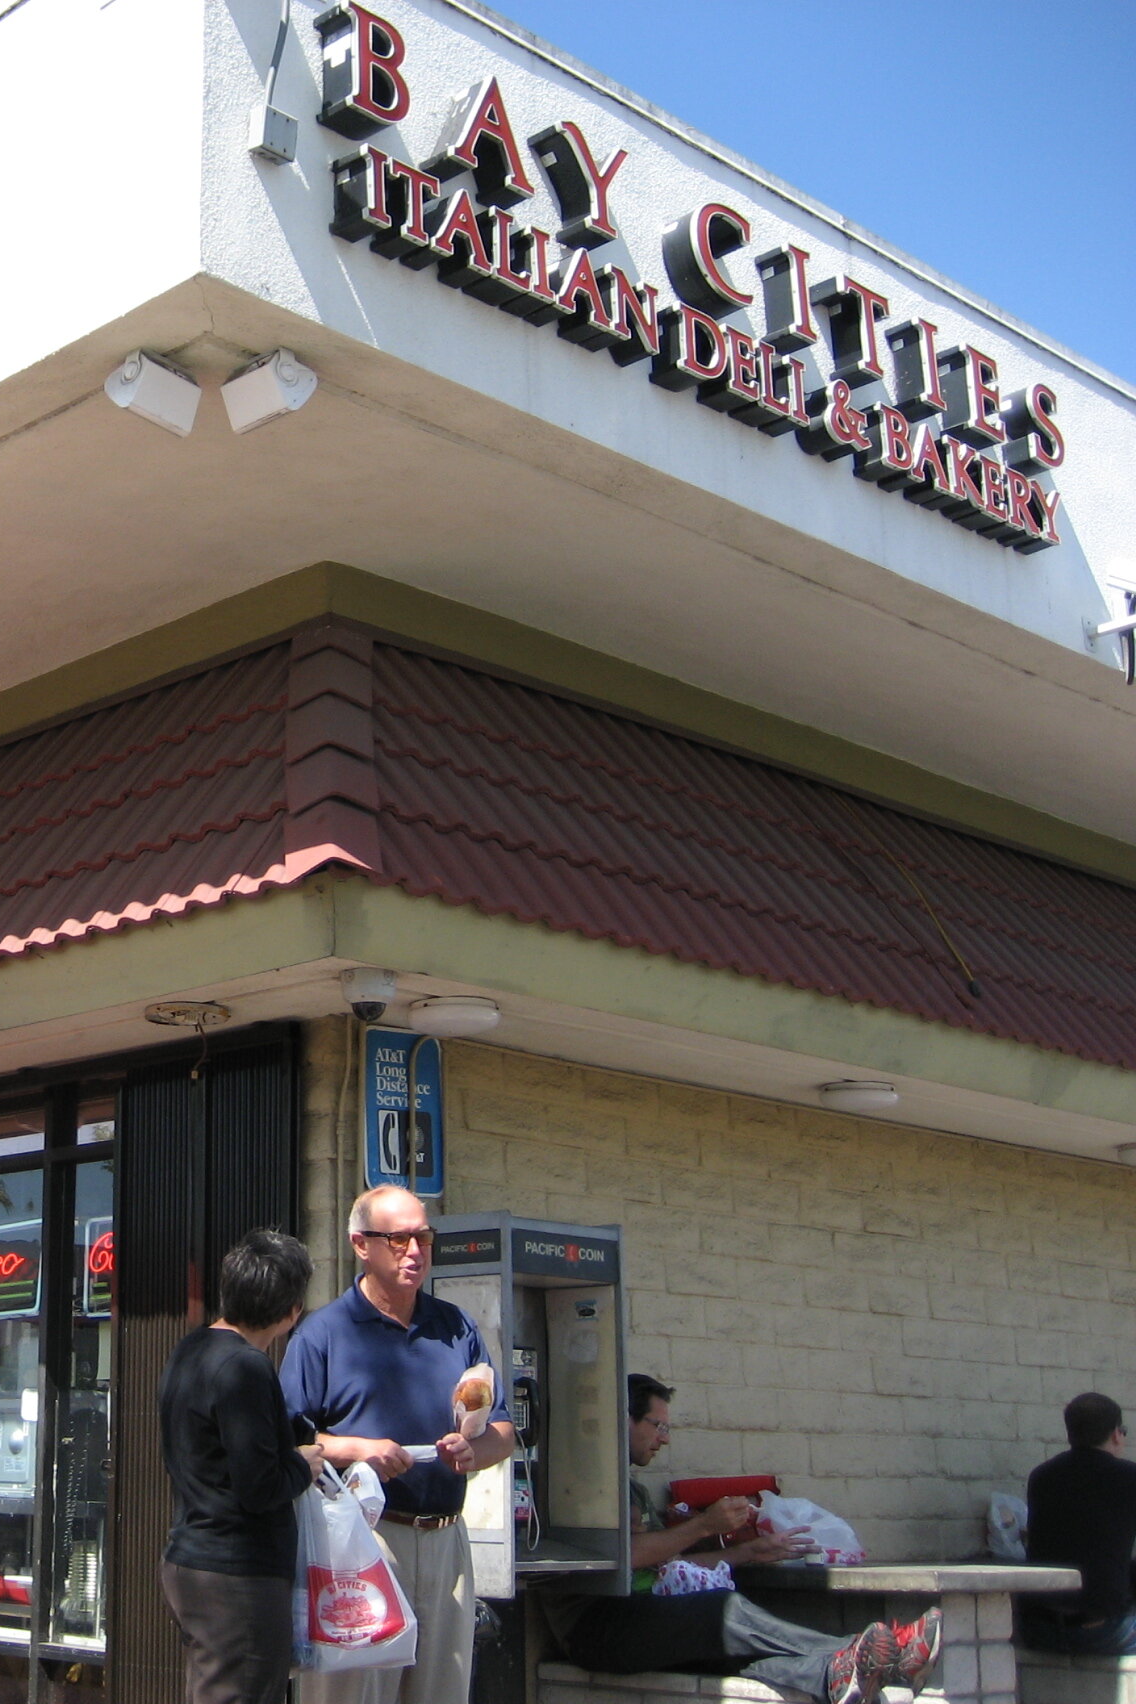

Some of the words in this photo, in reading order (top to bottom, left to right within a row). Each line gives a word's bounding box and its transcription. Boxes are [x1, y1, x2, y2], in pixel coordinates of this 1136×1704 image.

[346, 1, 627, 240] BAY
[689, 203, 1064, 471] CITIES
[362, 143, 660, 356] ITALIAN
[677, 302, 810, 427] DELI
[824, 379, 872, 451] &
[874, 401, 1061, 546] BAKERY
[375, 1048, 406, 1063] AT&T
[376, 1062, 407, 1083] Long
[376, 1077, 431, 1095] Distace
[376, 1093, 422, 1109] Servie
[440, 1244, 468, 1254] PACIFIC
[476, 1242, 495, 1251] COIN
[524, 1241, 565, 1258] PACIFIC
[578, 1248, 605, 1262] COIN
[337, 1581, 367, 1592] CITIES
